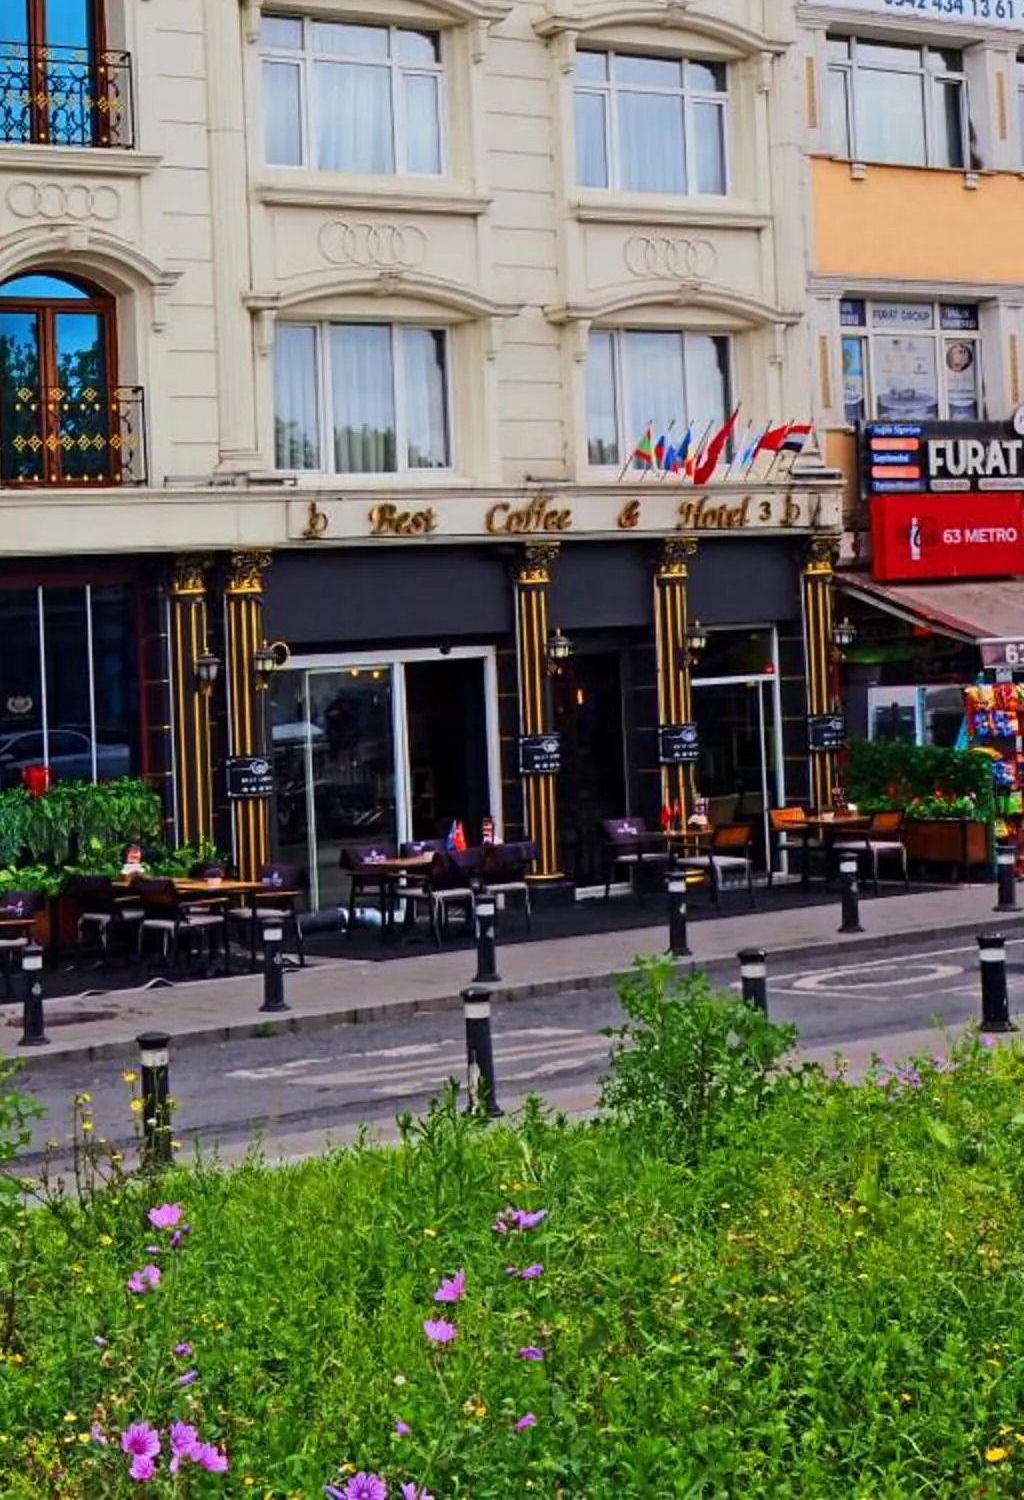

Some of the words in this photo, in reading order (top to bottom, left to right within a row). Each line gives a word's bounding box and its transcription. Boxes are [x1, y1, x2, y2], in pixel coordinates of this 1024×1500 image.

[928, 439, 1023, 476] FURAT
[368, 503, 438, 534] Best
[485, 492, 572, 534] Coffee
[677, 494, 752, 530] Hotel
[943, 529, 961, 543] 63
[964, 527, 1017, 543] METRO
